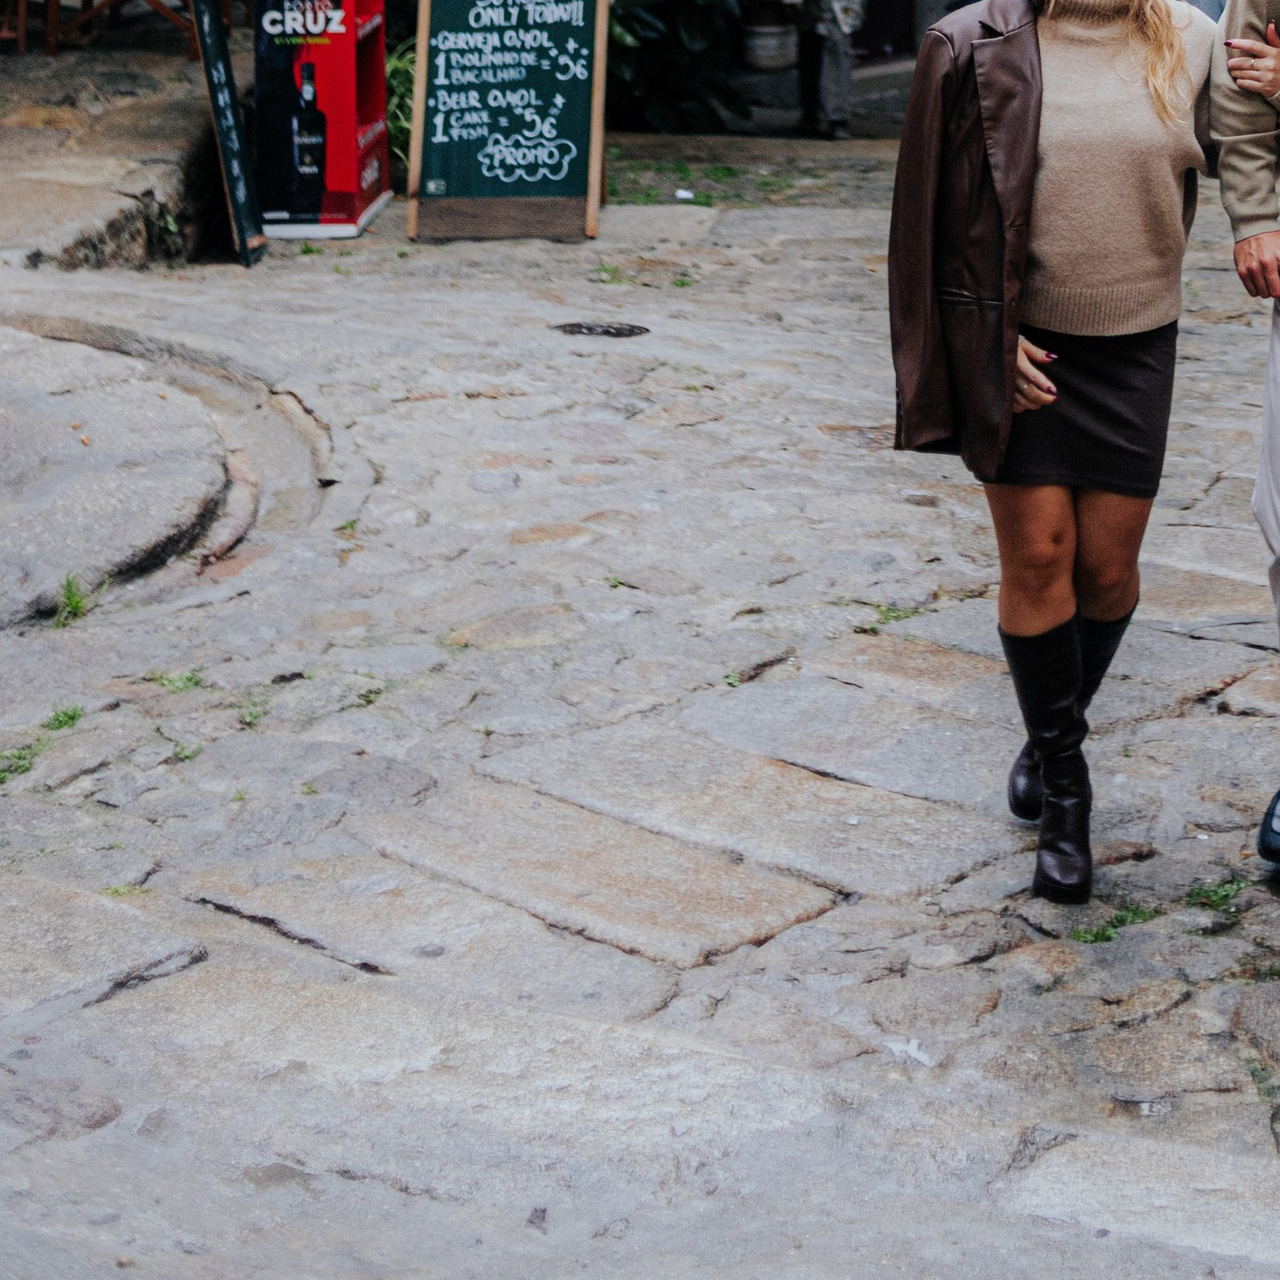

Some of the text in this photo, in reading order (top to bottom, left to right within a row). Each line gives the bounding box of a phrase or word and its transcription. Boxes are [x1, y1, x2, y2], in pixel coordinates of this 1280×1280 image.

[262, 9, 346, 36] CRUZ
[469, 5, 519, 28] ONLY
[433, 51, 449, 85] 1
[437, 89, 482, 111] BEER
[431, 112, 449, 143] 1
[491, 143, 560, 167] PROMO
